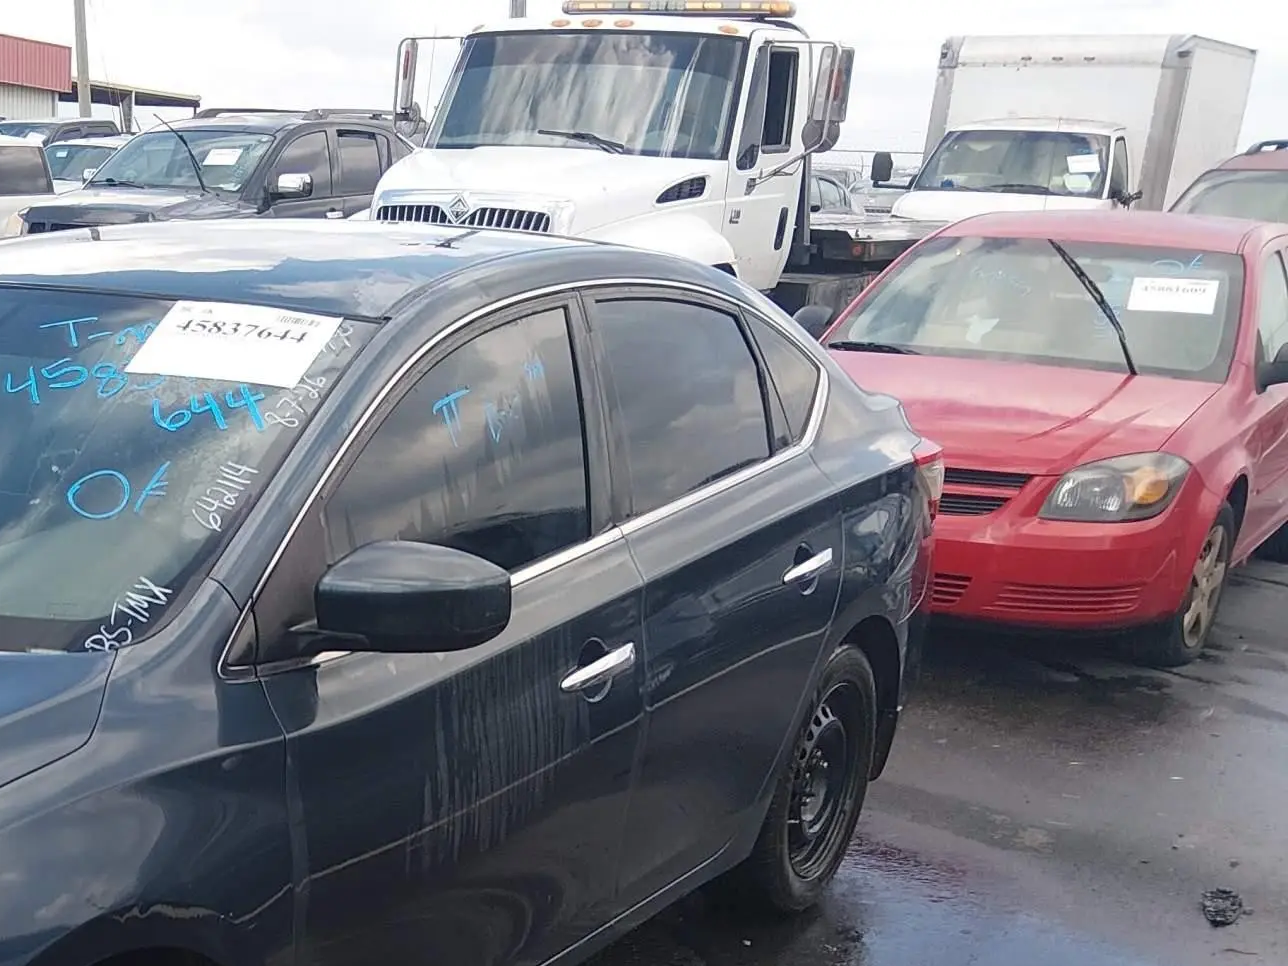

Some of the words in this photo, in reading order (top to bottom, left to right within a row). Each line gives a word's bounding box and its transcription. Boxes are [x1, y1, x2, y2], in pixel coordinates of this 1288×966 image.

[176, 319, 308, 343] 45837644
[152, 384, 266, 432] 644
[192, 461, 259, 532] 642114
